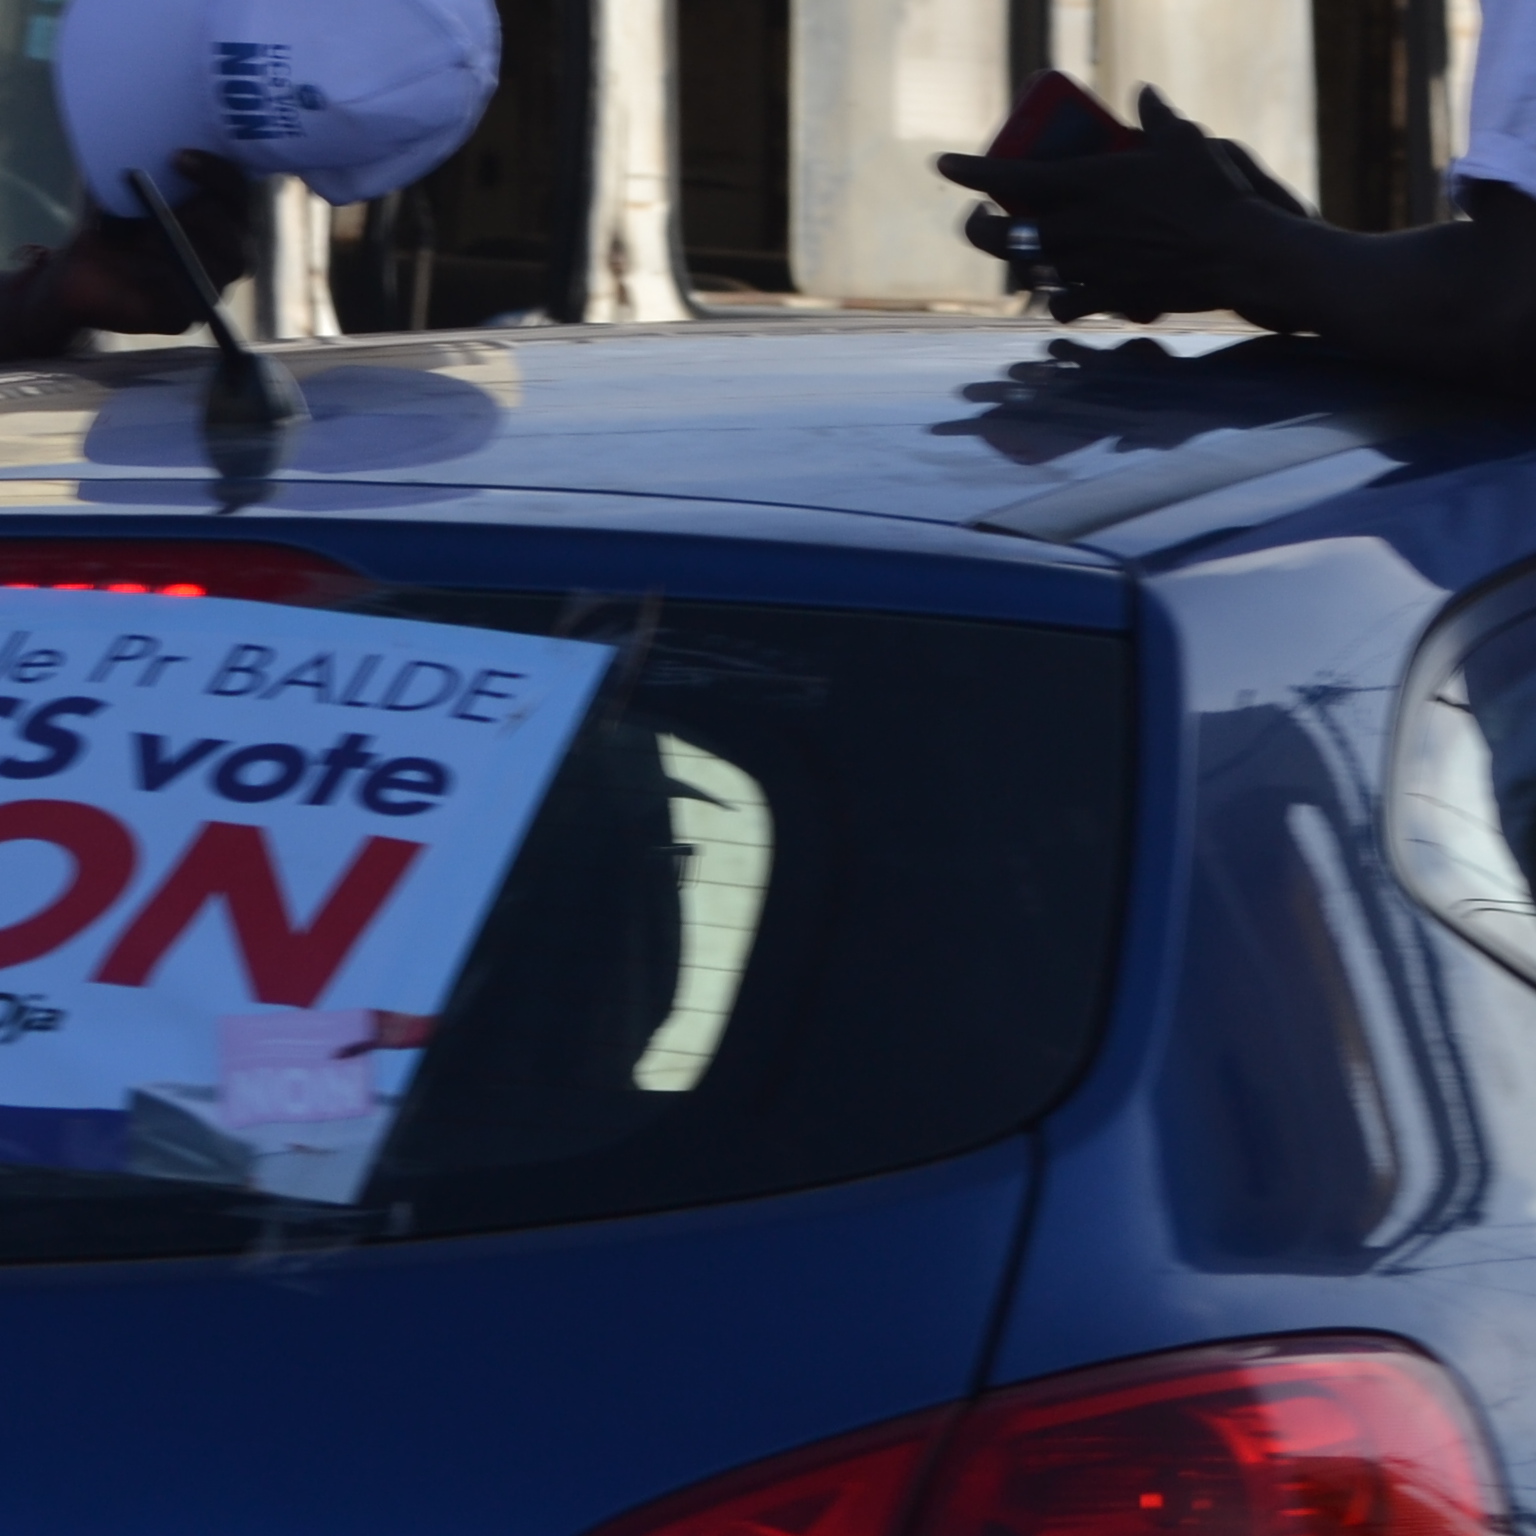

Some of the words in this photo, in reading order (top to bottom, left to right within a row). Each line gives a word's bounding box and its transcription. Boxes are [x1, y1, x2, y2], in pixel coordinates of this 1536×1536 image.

[211, 41, 284, 141] NON
[84, 633, 190, 688] Pr
[203, 643, 530, 724] BALDE
[128, 732, 456, 817] vote
